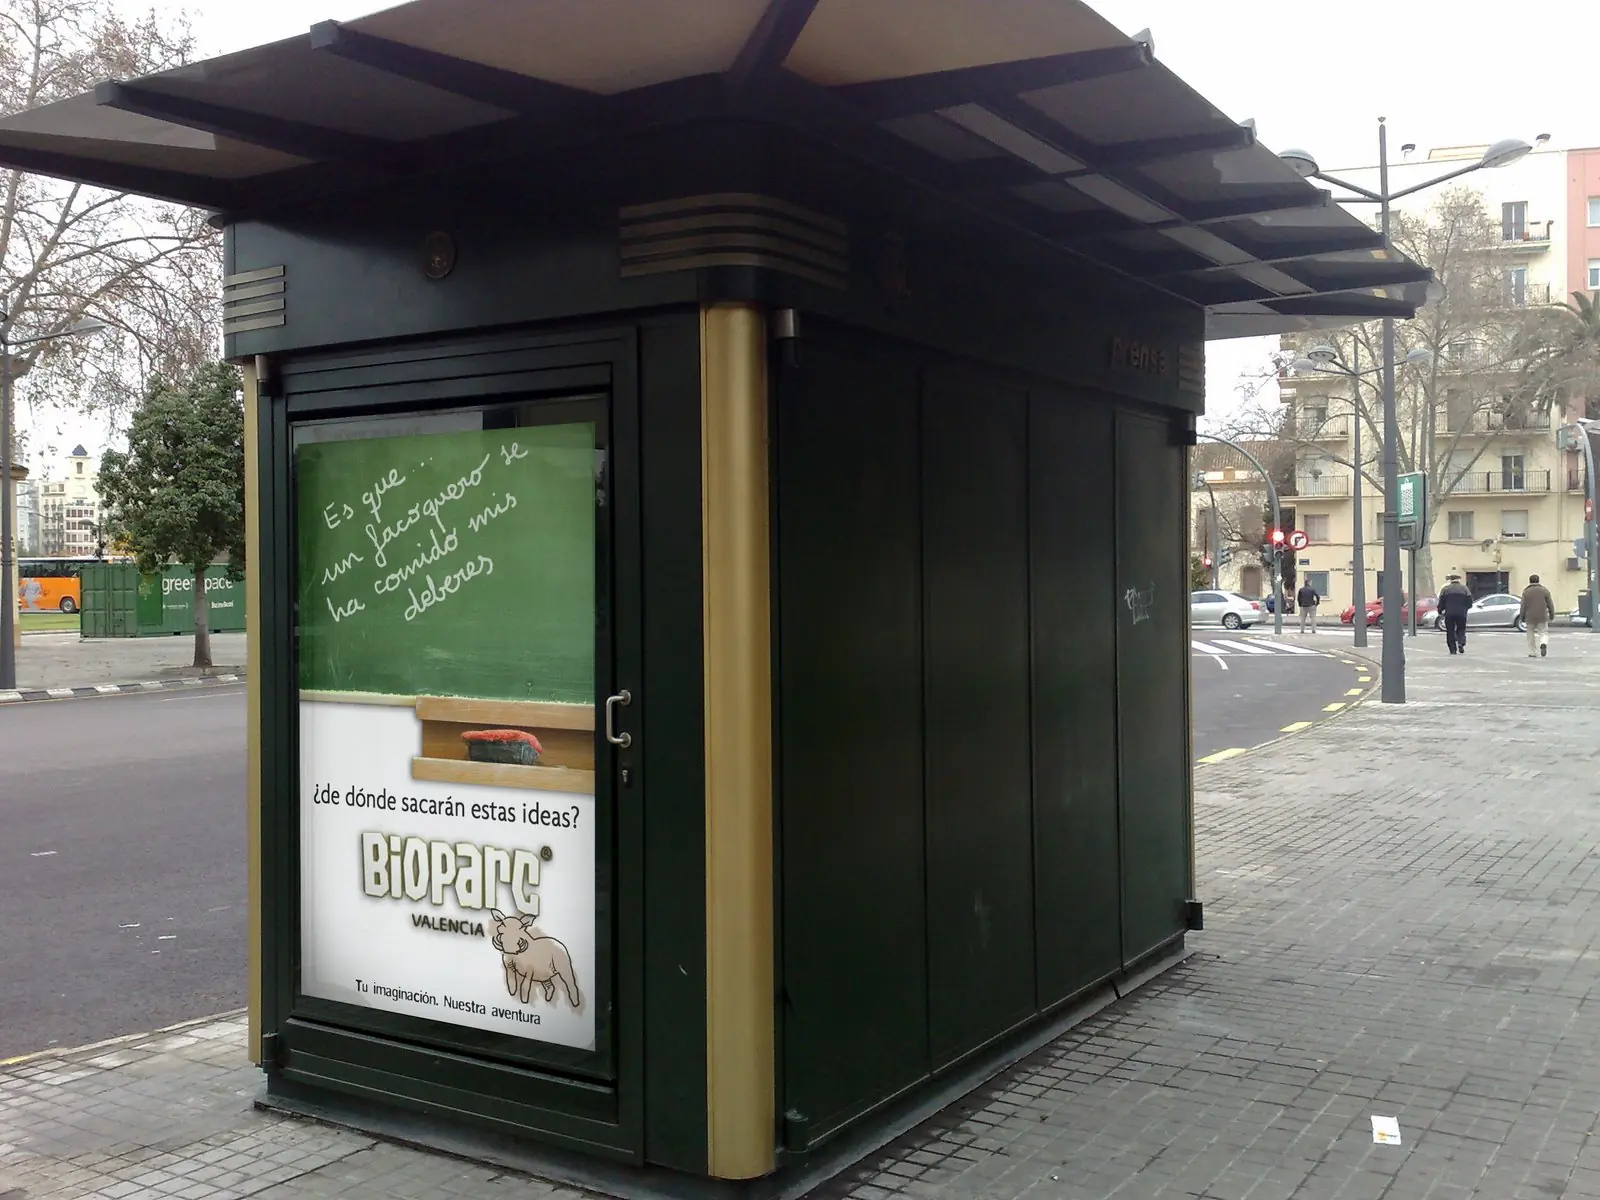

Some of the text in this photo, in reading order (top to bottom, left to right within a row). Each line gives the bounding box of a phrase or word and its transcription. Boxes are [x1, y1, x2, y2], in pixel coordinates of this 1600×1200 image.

[321, 552, 364, 585] un
[501, 442, 528, 465] se
[322, 502, 354, 530] Es
[326, 492, 518, 622] ha comido mis
[404, 555, 494, 621] deberes
[313, 783, 580, 829] ¿de dónde sacarán estas ideas?
[411, 913, 485, 938] VALENCIA
[355, 979, 541, 1026] Tu imaginación. Nuestra aventura
